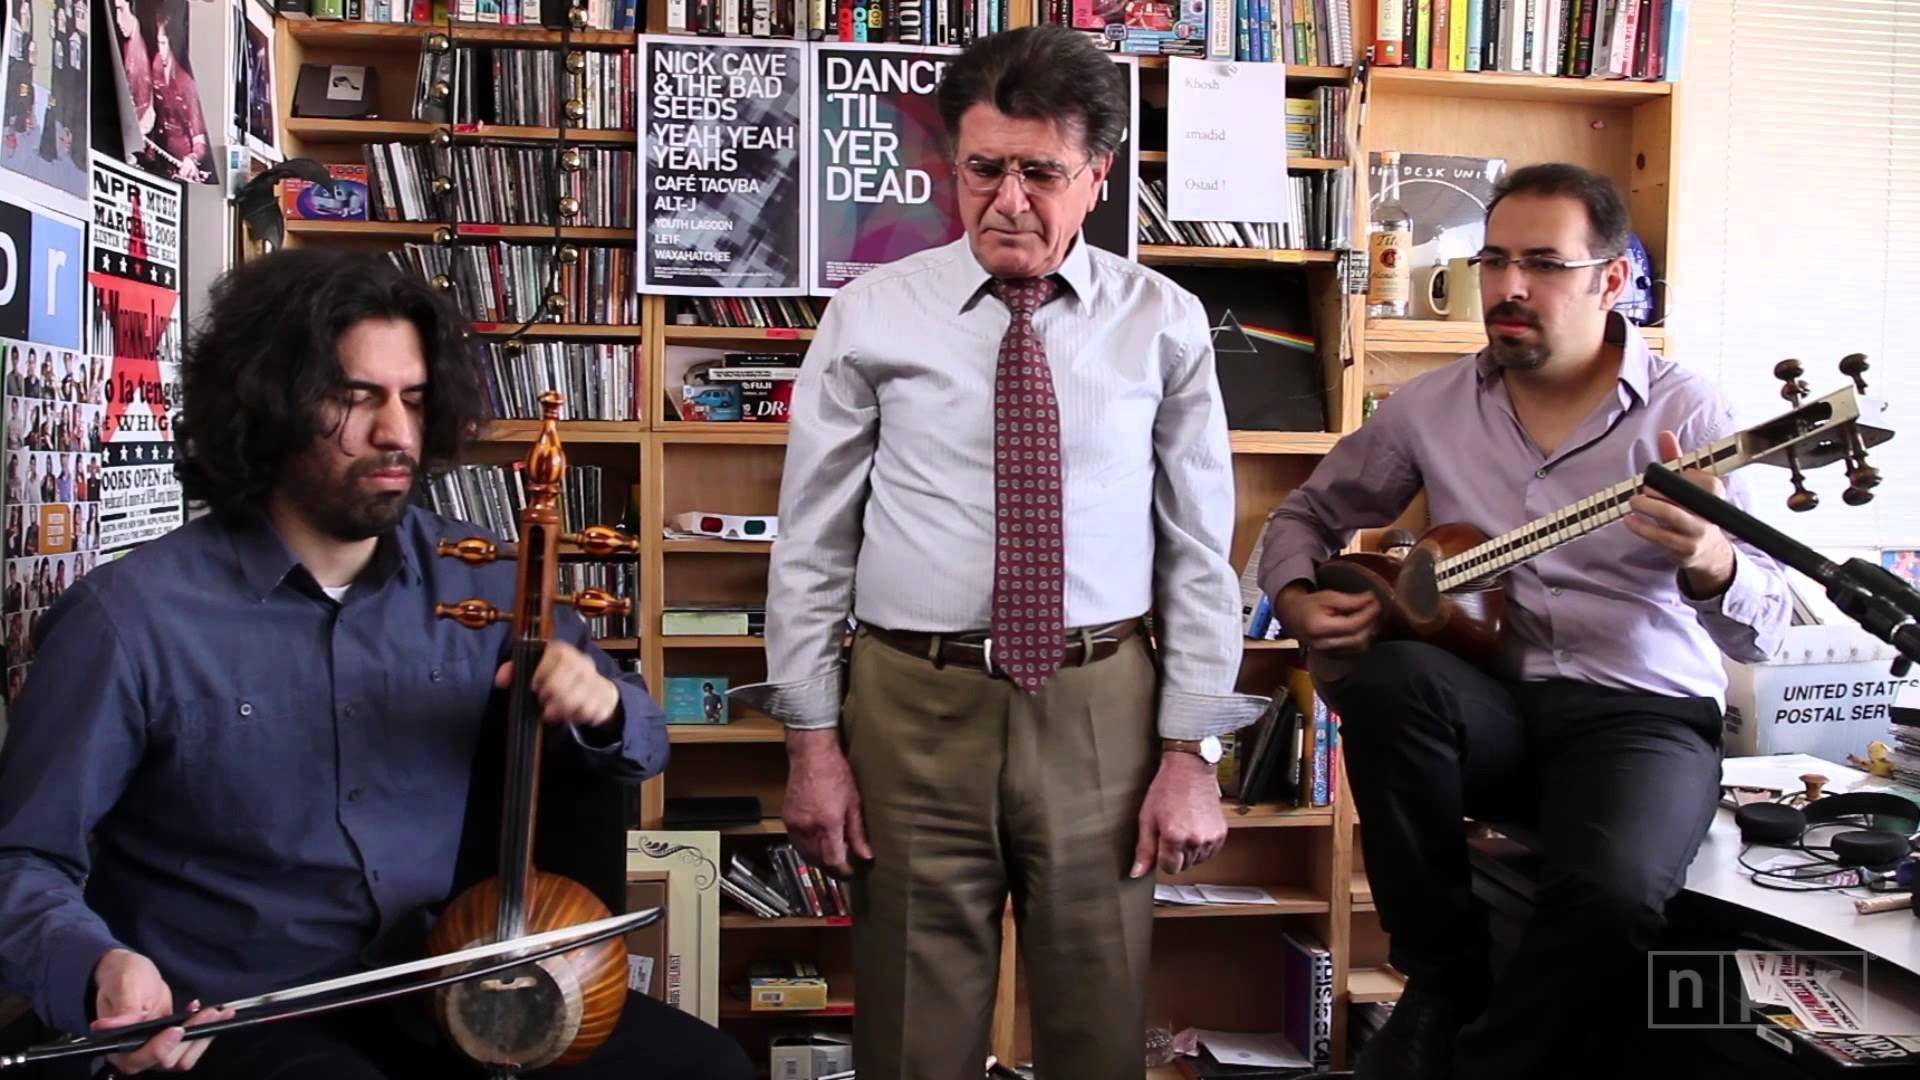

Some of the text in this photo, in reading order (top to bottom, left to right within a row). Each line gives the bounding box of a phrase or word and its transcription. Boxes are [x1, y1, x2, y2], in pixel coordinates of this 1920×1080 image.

[654, 50, 787, 76] NICK CAVE
[654, 73, 782, 99] &THE BAD
[1184, 77, 1219, 90] Khosh
[653, 96, 738, 120] SEEDS
[826, 92, 893, 129] 'TIL
[652, 123, 793, 149] YEAH YEAH
[1185, 129, 1226, 141] amadid
[653, 146, 738, 171] YEAHS
[823, 128, 899, 166] YER
[654, 174, 760, 193] CAFÉ TACVBA
[1404, 166, 1446, 178] DESK
[93, 169, 177, 218] NPR MUSIC
[826, 166, 931, 204] DEAD
[1185, 178, 1218, 190] Ostad
[654, 196, 696, 212] ALT-J
[655, 218, 733, 231] YOUTH LAGOON
[655, 249, 731, 262] WAXAHATCHEE
[105, 379, 115, 404] o
[119, 371, 134, 404] la
[757, 400, 790, 416] DR-
[116, 414, 169, 431] WHIG
[102, 471, 132, 491] OORS
[134, 468, 160, 488] OPEN
[1784, 679, 1919, 702] UNITED STAT
[1775, 706, 1846, 724] POSTAL
